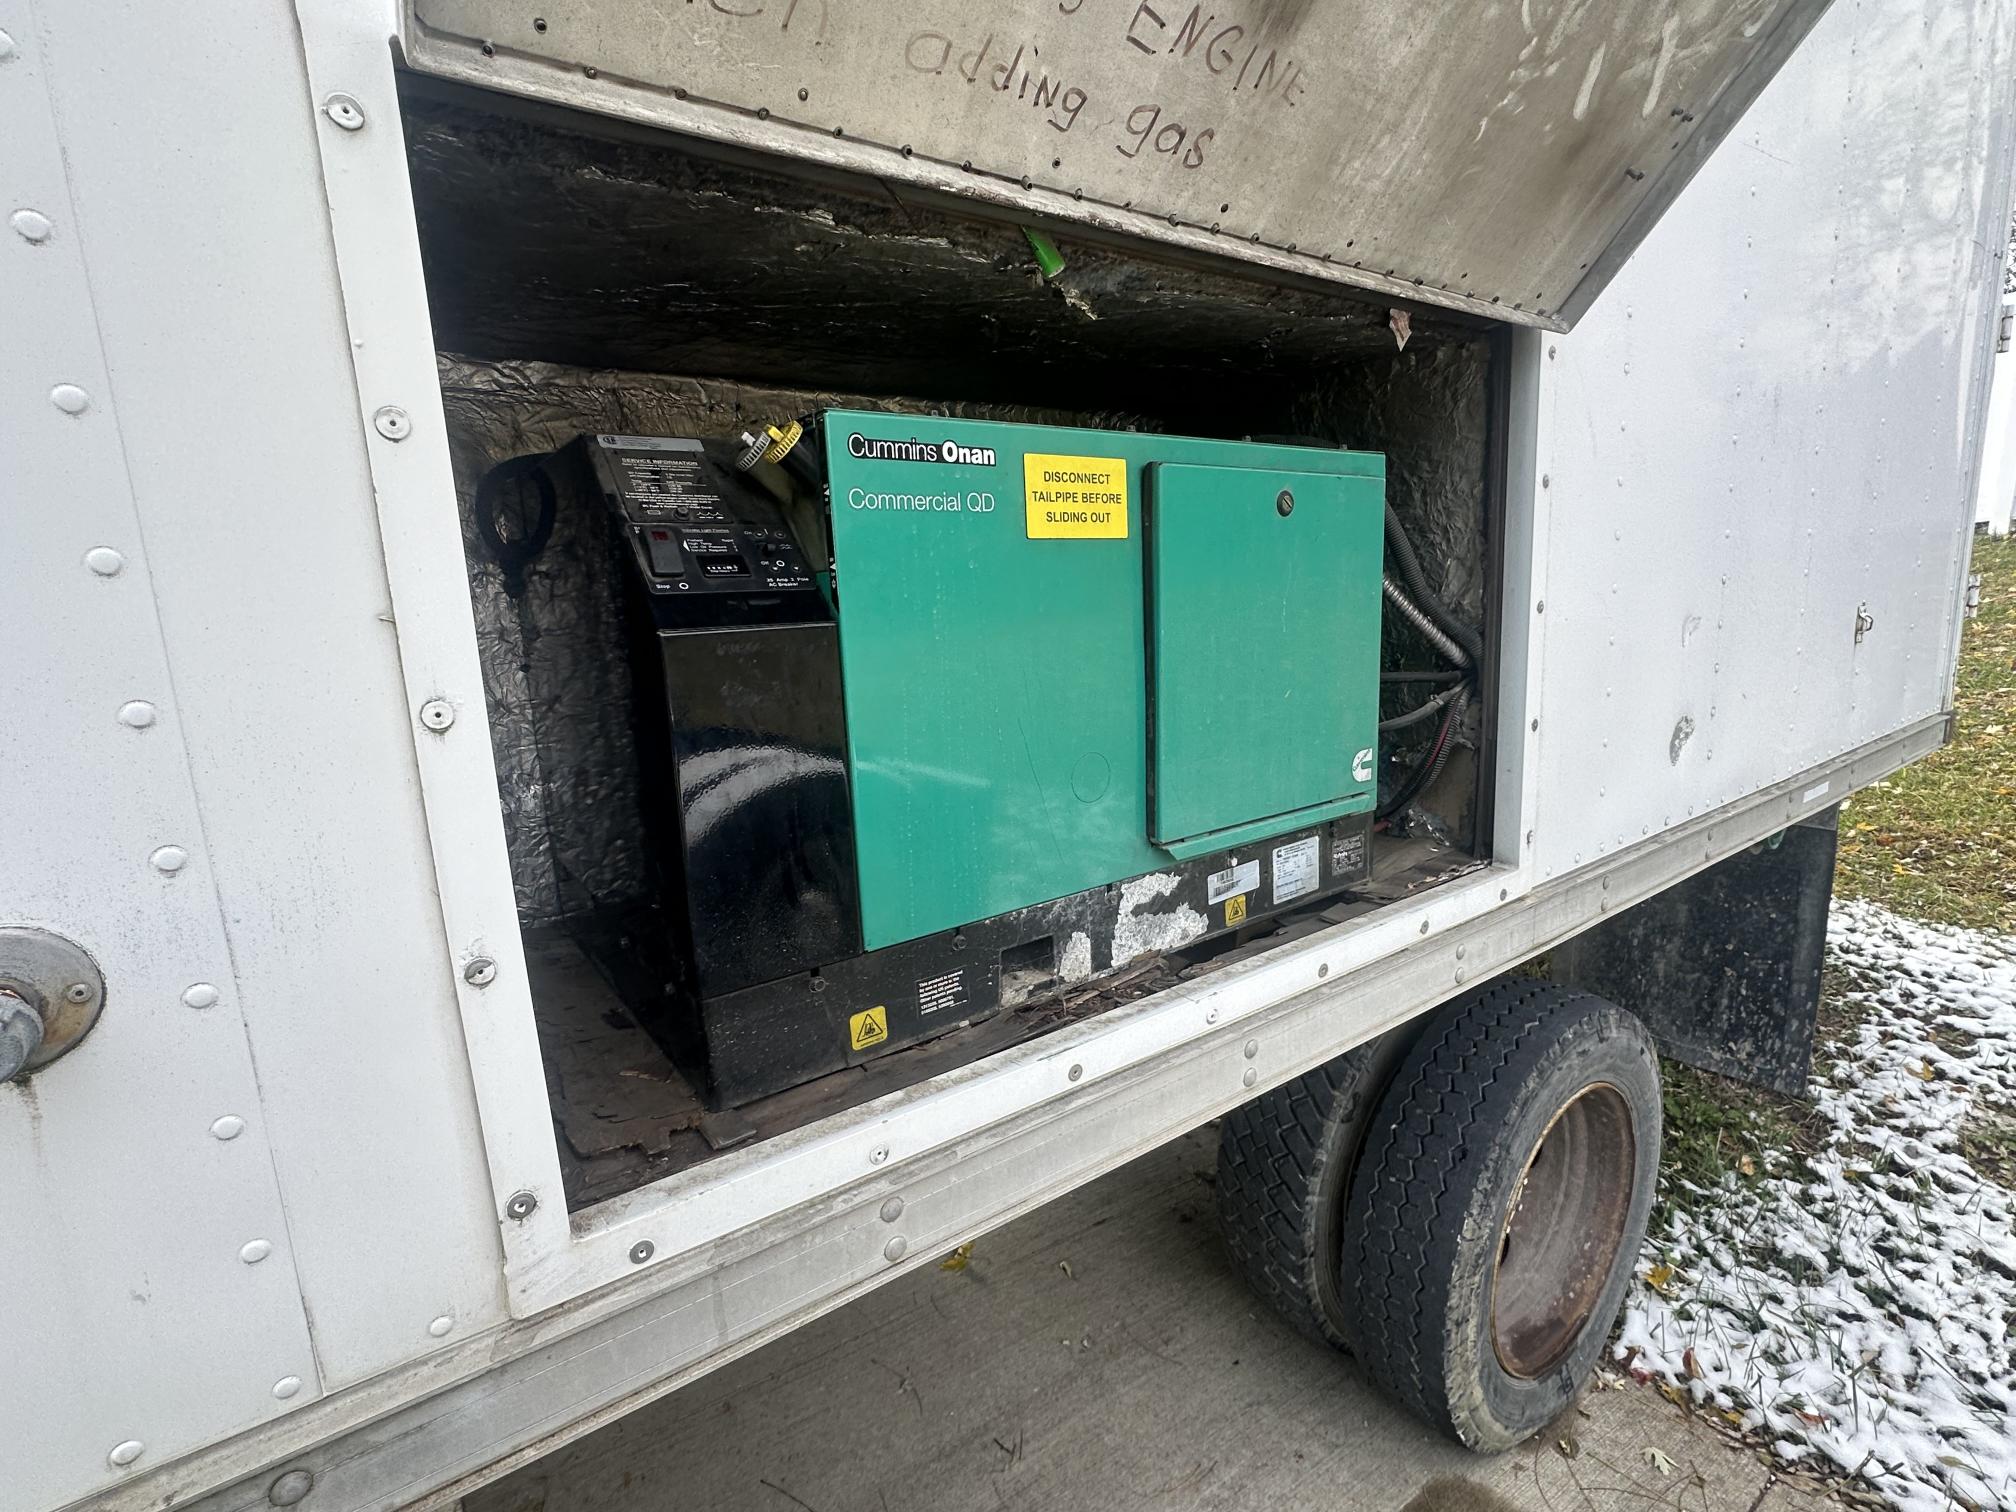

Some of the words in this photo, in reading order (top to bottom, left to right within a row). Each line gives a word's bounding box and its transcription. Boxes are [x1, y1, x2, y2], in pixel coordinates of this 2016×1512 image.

[1126, 0, 1304, 106] ENGINE
[1116, 105, 1214, 170] gas
[849, 434, 937, 461] Cummins
[942, 440, 995, 465] Onan
[1043, 471, 1111, 485] DISCONNECT
[849, 488, 961, 512] Commercial
[966, 493, 995, 513] QD
[1032, 491, 1078, 504] TAILPIPE
[1081, 492, 1122, 504] BEFORE
[1046, 512, 1088, 523] SLIDING
[1090, 513, 1111, 523] OUT
